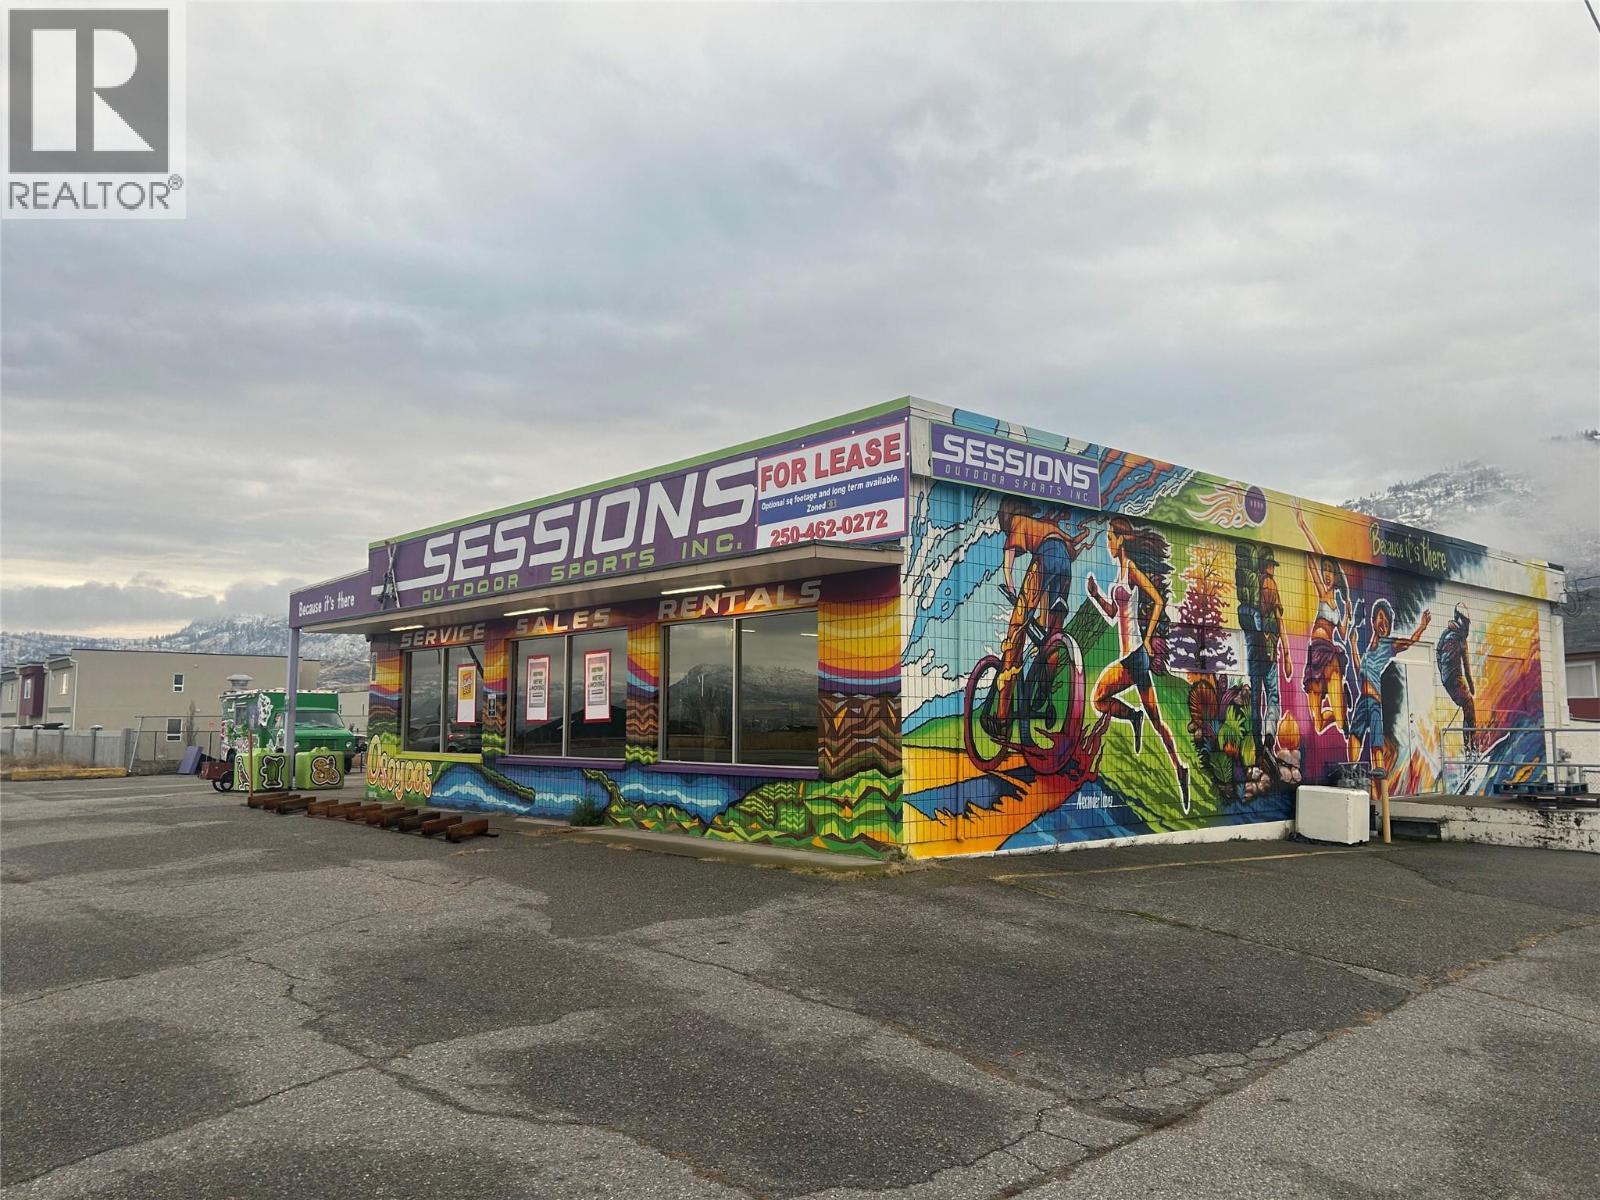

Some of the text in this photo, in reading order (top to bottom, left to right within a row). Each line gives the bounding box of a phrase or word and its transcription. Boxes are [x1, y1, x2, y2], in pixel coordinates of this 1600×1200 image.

[760, 433, 901, 492] FOR LEASE
[931, 433, 1099, 490] SESSIONS
[945, 464, 1090, 502] OUTDOOR SPORTS INC.
[761, 498, 785, 511] Optional
[794, 492, 817, 504] footage
[818, 488, 831, 498] and
[832, 485, 846, 496] long
[847, 482, 864, 492] term
[865, 475, 900, 488] available.
[806, 500, 827, 512] Zoned
[371, 457, 757, 596] SESSIONS
[770, 509, 888, 547] 250-462-0272
[1369, 522, 1447, 571] Because it's there
[422, 533, 742, 603] OUTDOOR SPORTS INC.
[298, 590, 355, 617] Because it's there
[400, 579, 822, 648] SERVICE SALES RENTALS
[367, 733, 433, 801] Osoyoos
